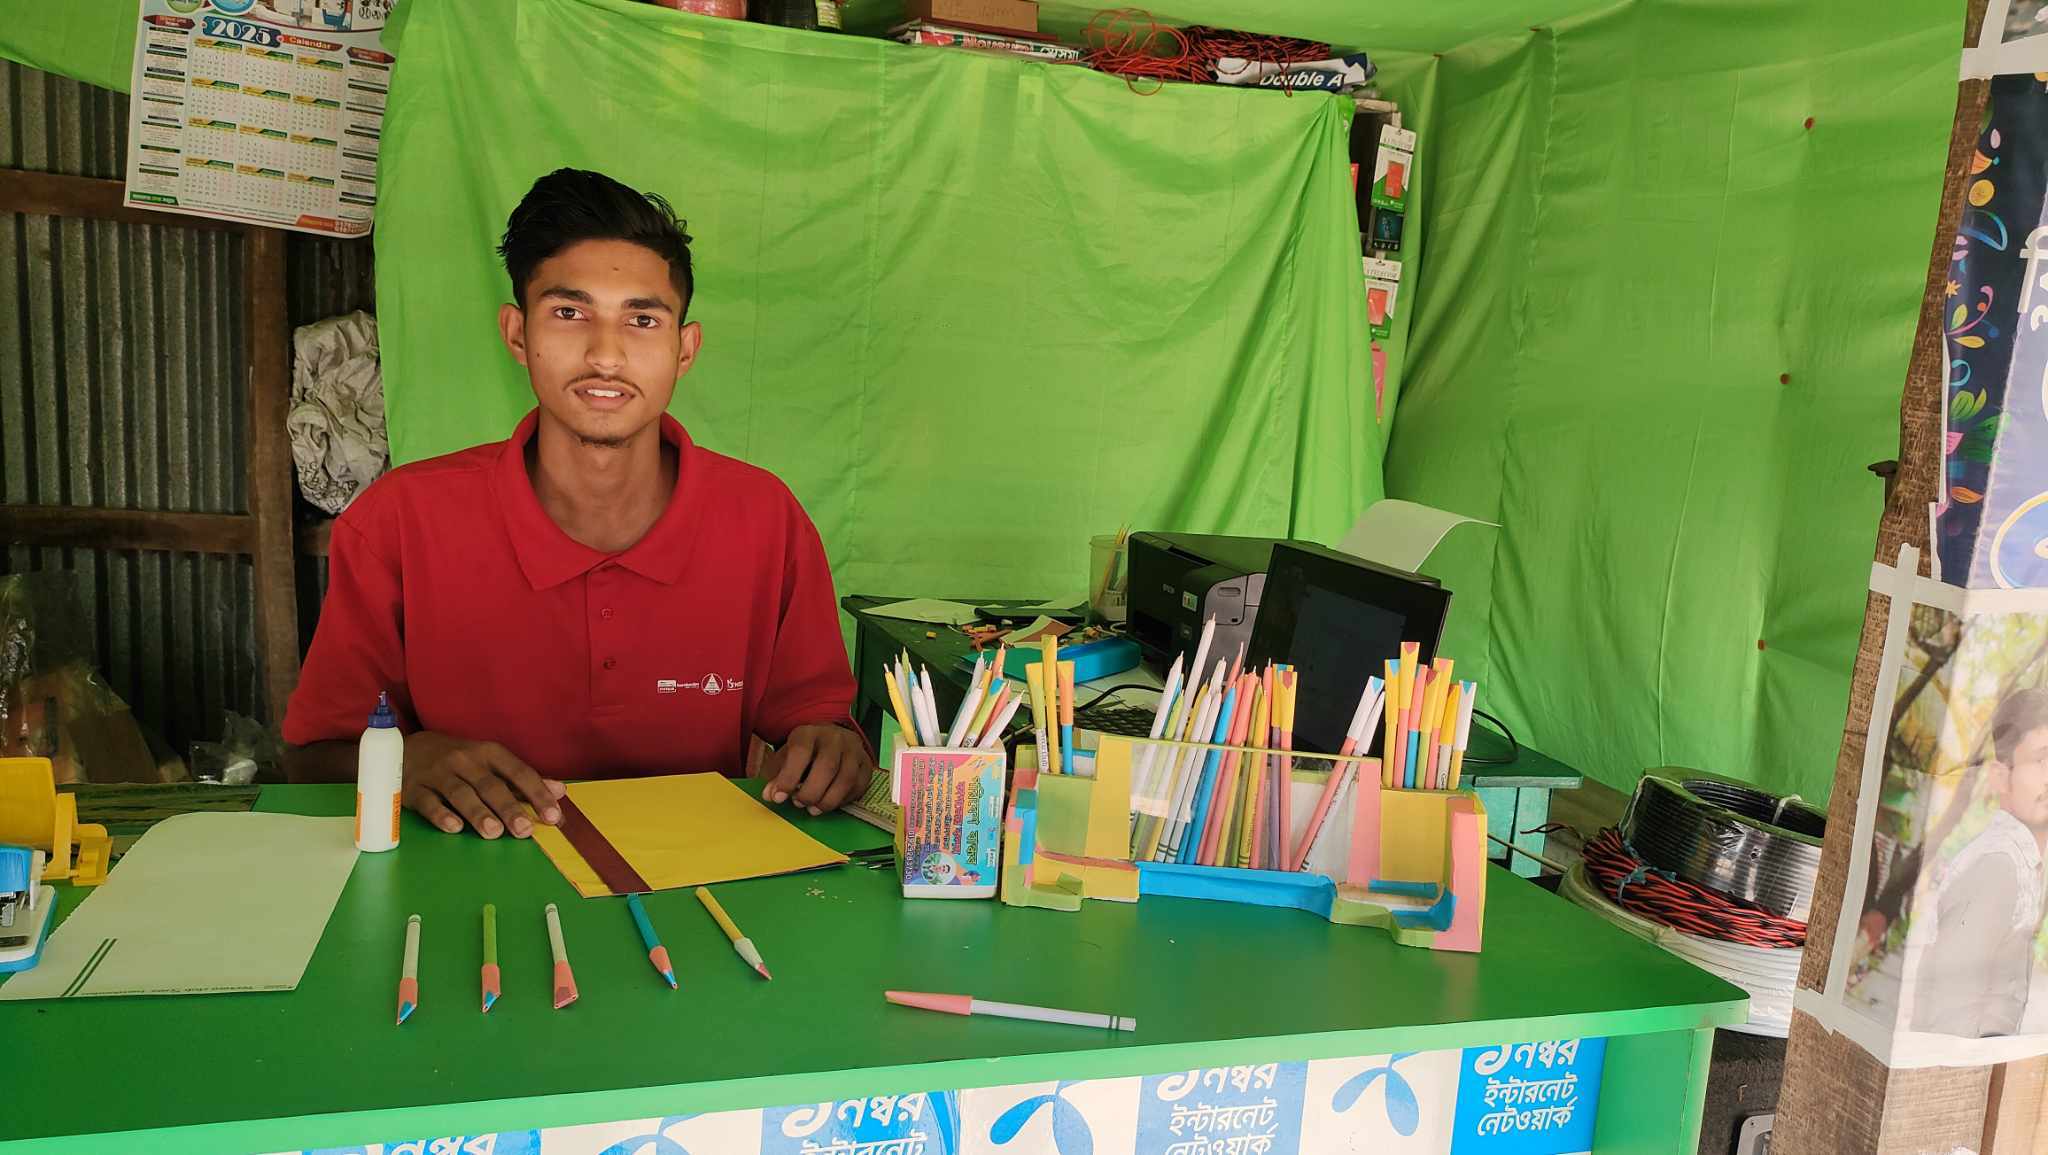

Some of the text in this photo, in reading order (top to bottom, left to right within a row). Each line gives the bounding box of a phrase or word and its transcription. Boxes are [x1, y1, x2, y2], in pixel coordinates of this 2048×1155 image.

[211, 19, 271, 45] 2025
[289, 36, 331, 50] Calendar
[1327, 73, 1343, 87] A
[1484, 1072, 1578, 1107] ইন্টারনেট
[1169, 1097, 1278, 1136] ইন্টারনেট
[1477, 1096, 1578, 1136] নেটওয়ার্ক
